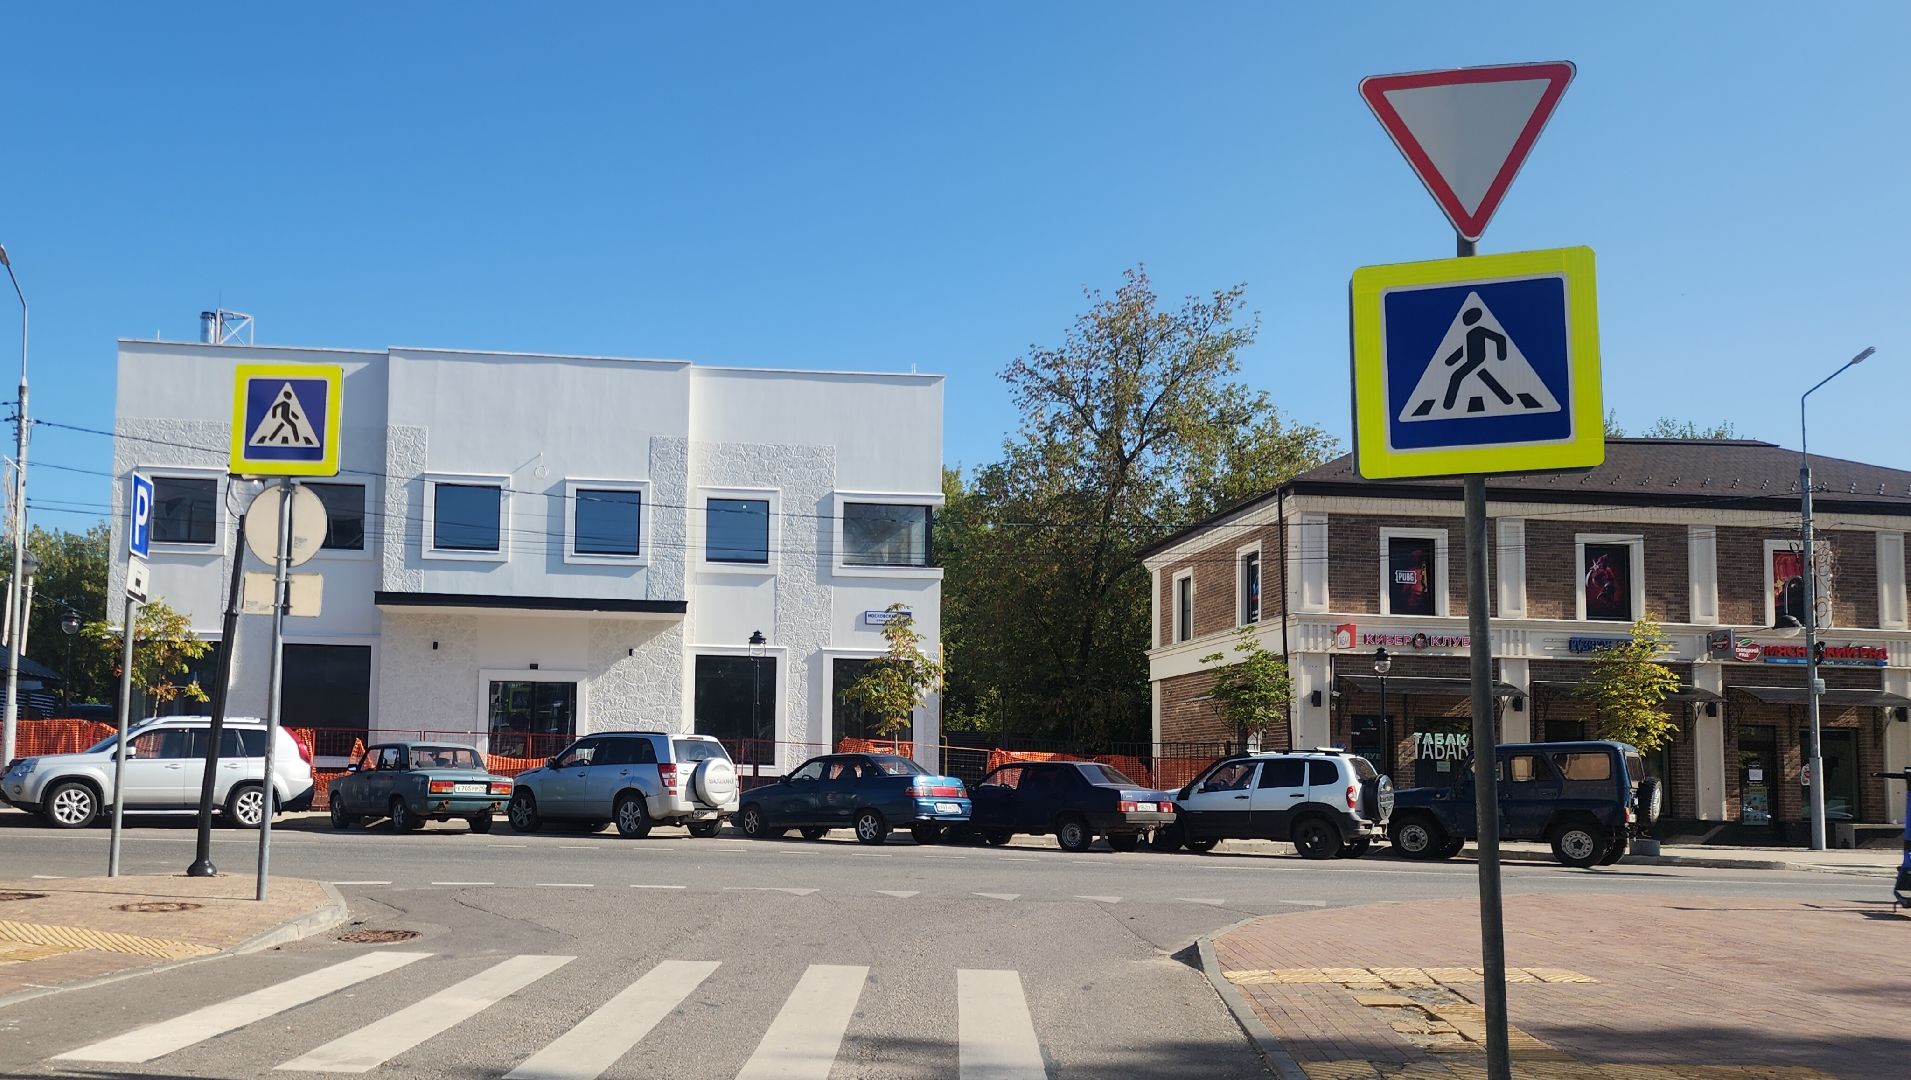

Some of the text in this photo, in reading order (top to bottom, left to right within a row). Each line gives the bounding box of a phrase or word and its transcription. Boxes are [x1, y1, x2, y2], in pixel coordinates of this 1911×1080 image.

[135, 484, 149, 545] P
[1398, 572, 1415, 582] PUBG
[1364, 633, 1412, 646] КИБЕР
[1429, 635, 1470, 648] КЛУБ
[1764, 645, 1855, 659] МЯСНКИЙ
[1413, 732, 1467, 746] ТАБАК
[1413, 738, 1470, 760] ТАБАК
